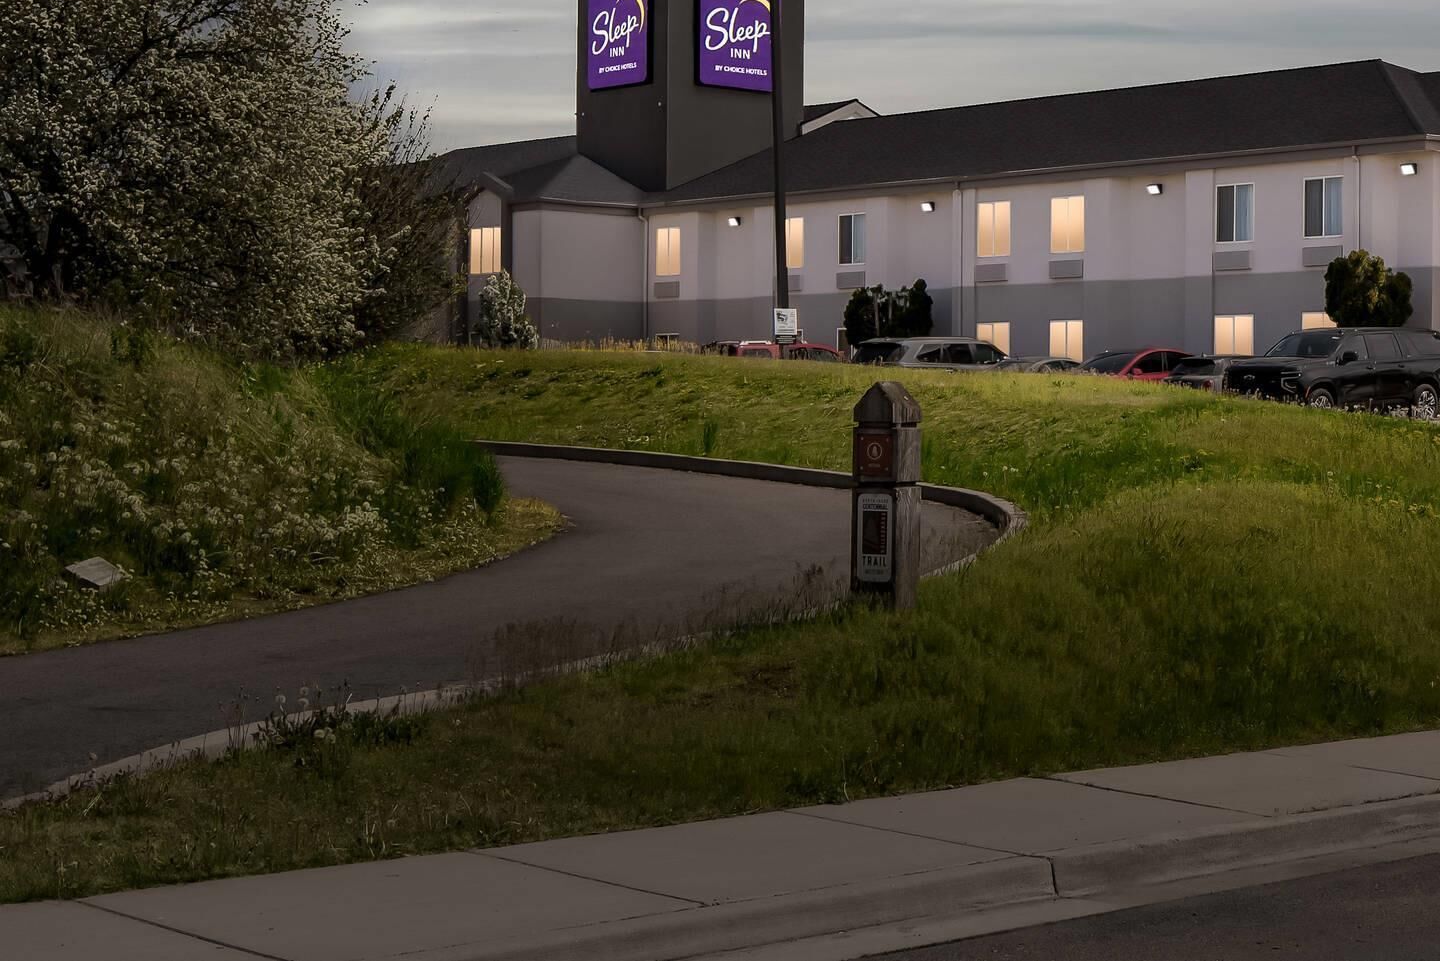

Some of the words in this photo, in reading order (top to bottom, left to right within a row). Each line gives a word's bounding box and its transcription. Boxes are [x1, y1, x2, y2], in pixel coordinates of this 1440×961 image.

[592, 7, 639, 55] Sleep
[705, 7, 770, 52] Sleep
[609, 46, 625, 58] INN
[730, 47, 751, 59] INN
[605, 64, 620, 73] CHOICE
[621, 62, 637, 70] HOTELS
[723, 65, 745, 74] CHOICE
[746, 67, 768, 76] HOTELS
[863, 555, 886, 568] TRAIL
